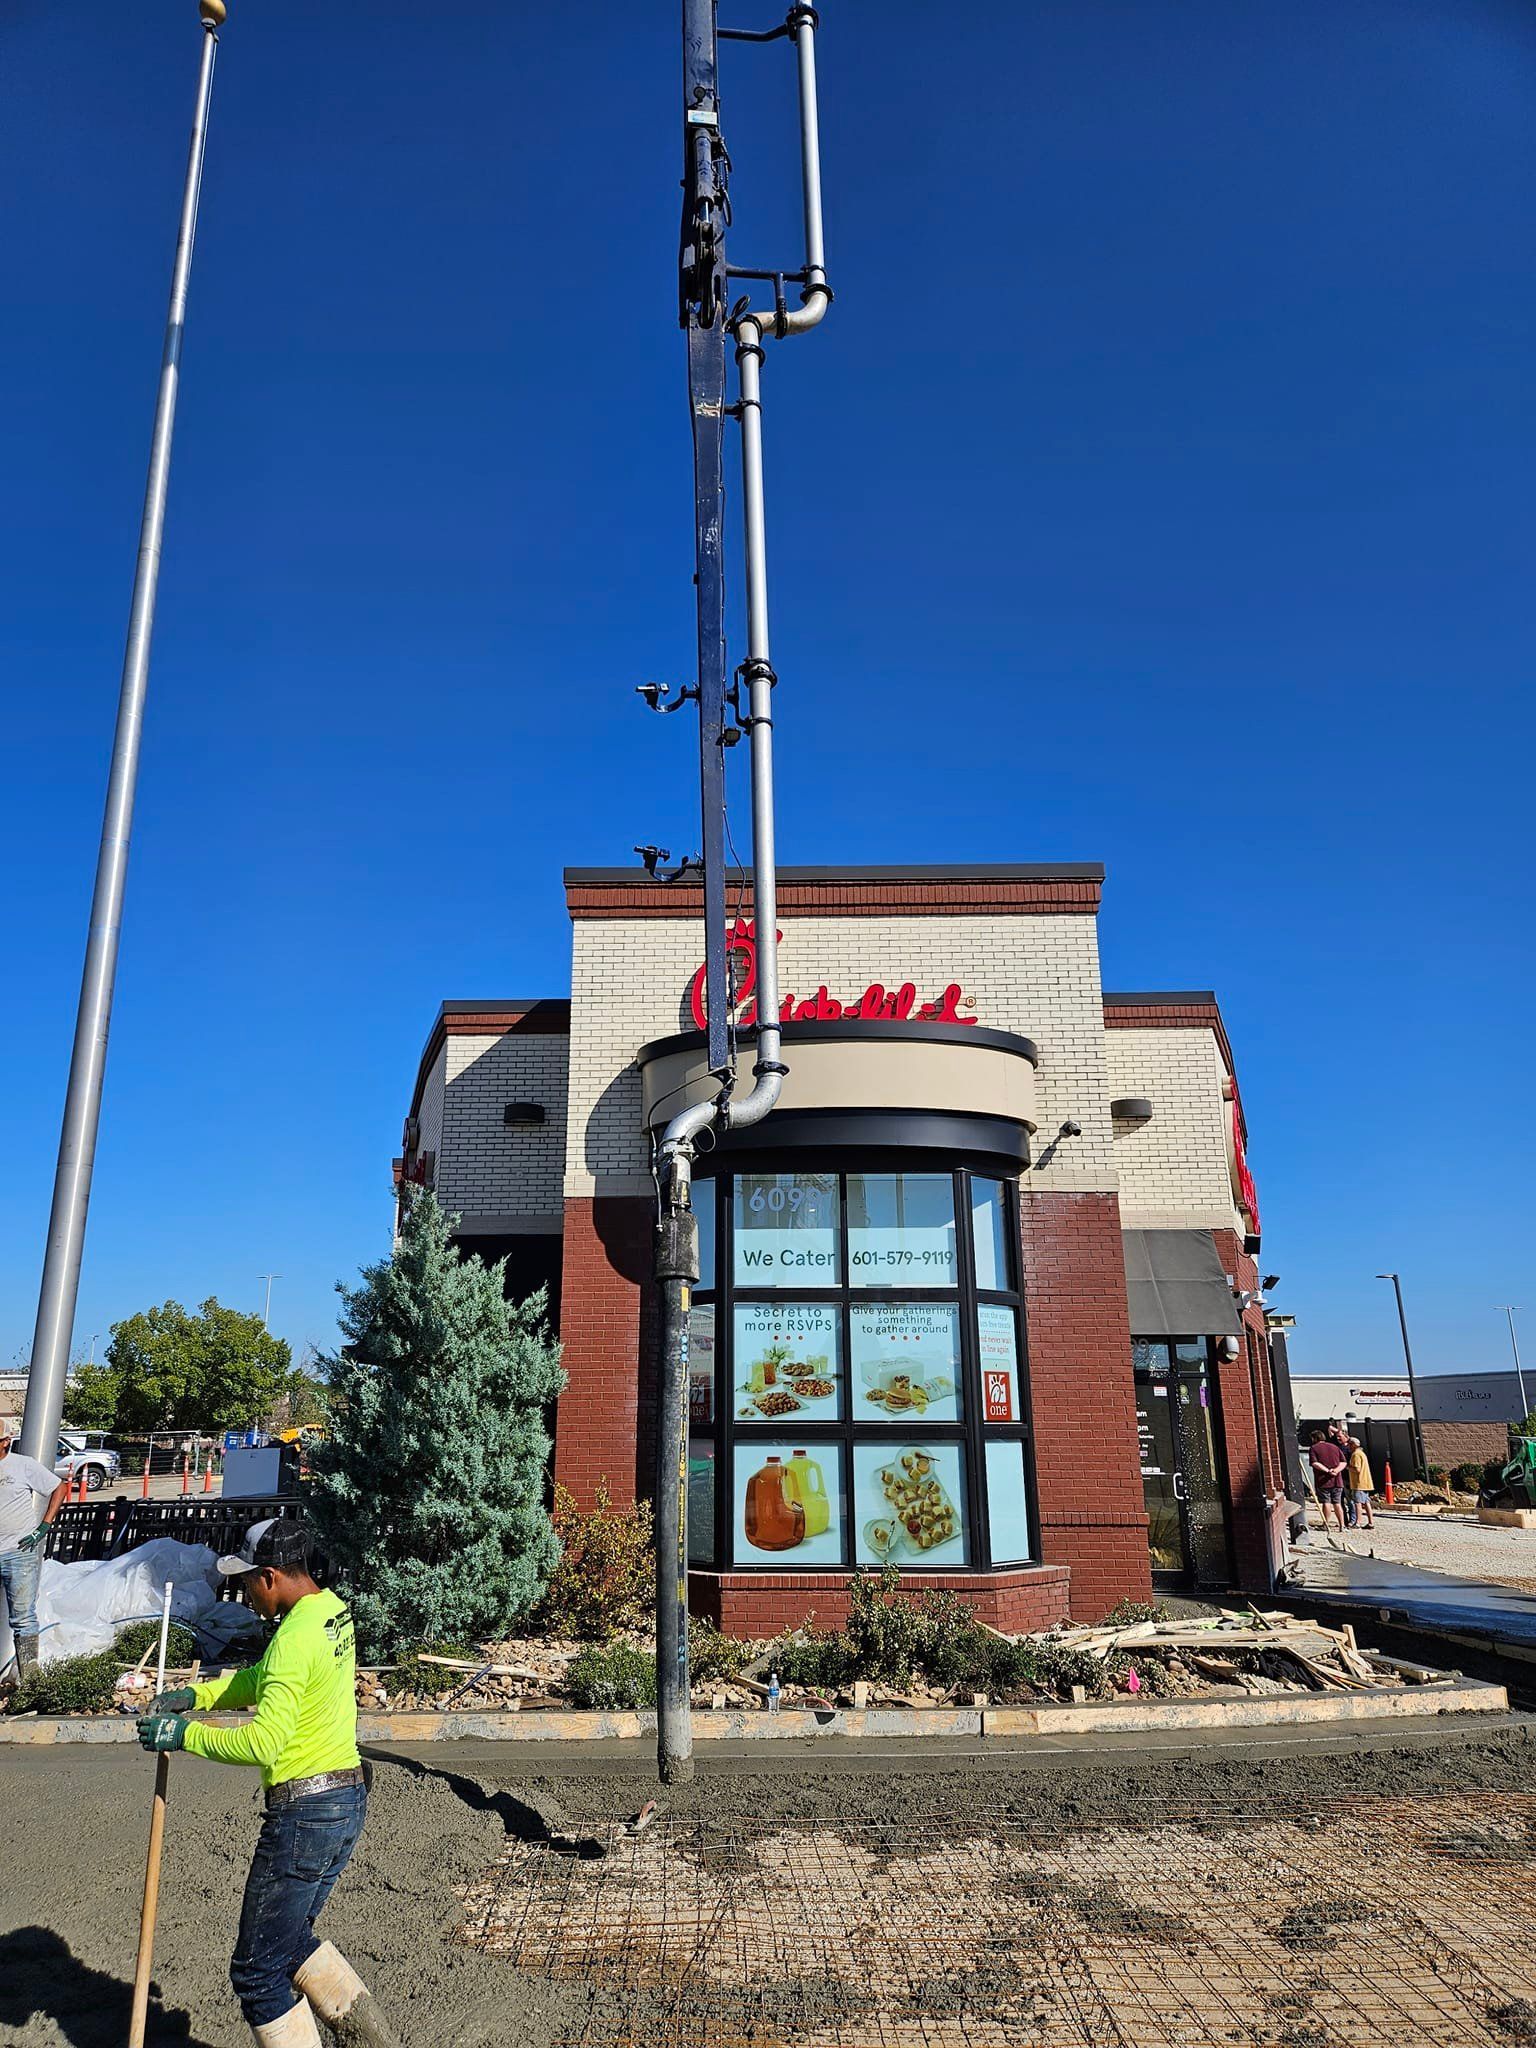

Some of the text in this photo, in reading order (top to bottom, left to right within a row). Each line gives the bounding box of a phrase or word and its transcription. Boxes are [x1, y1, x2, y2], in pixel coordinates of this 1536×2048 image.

[743, 1249, 835, 1266] We Cater
[852, 1251, 953, 1265] 601-579-9119
[754, 1306, 822, 1318] Secret to
[852, 1305, 957, 1317] Give your gatherings
[745, 1319, 832, 1331] more RSVPS
[878, 1315, 932, 1326] something
[862, 1324, 948, 1335] to gather around
[990, 1405, 1008, 1416] one
